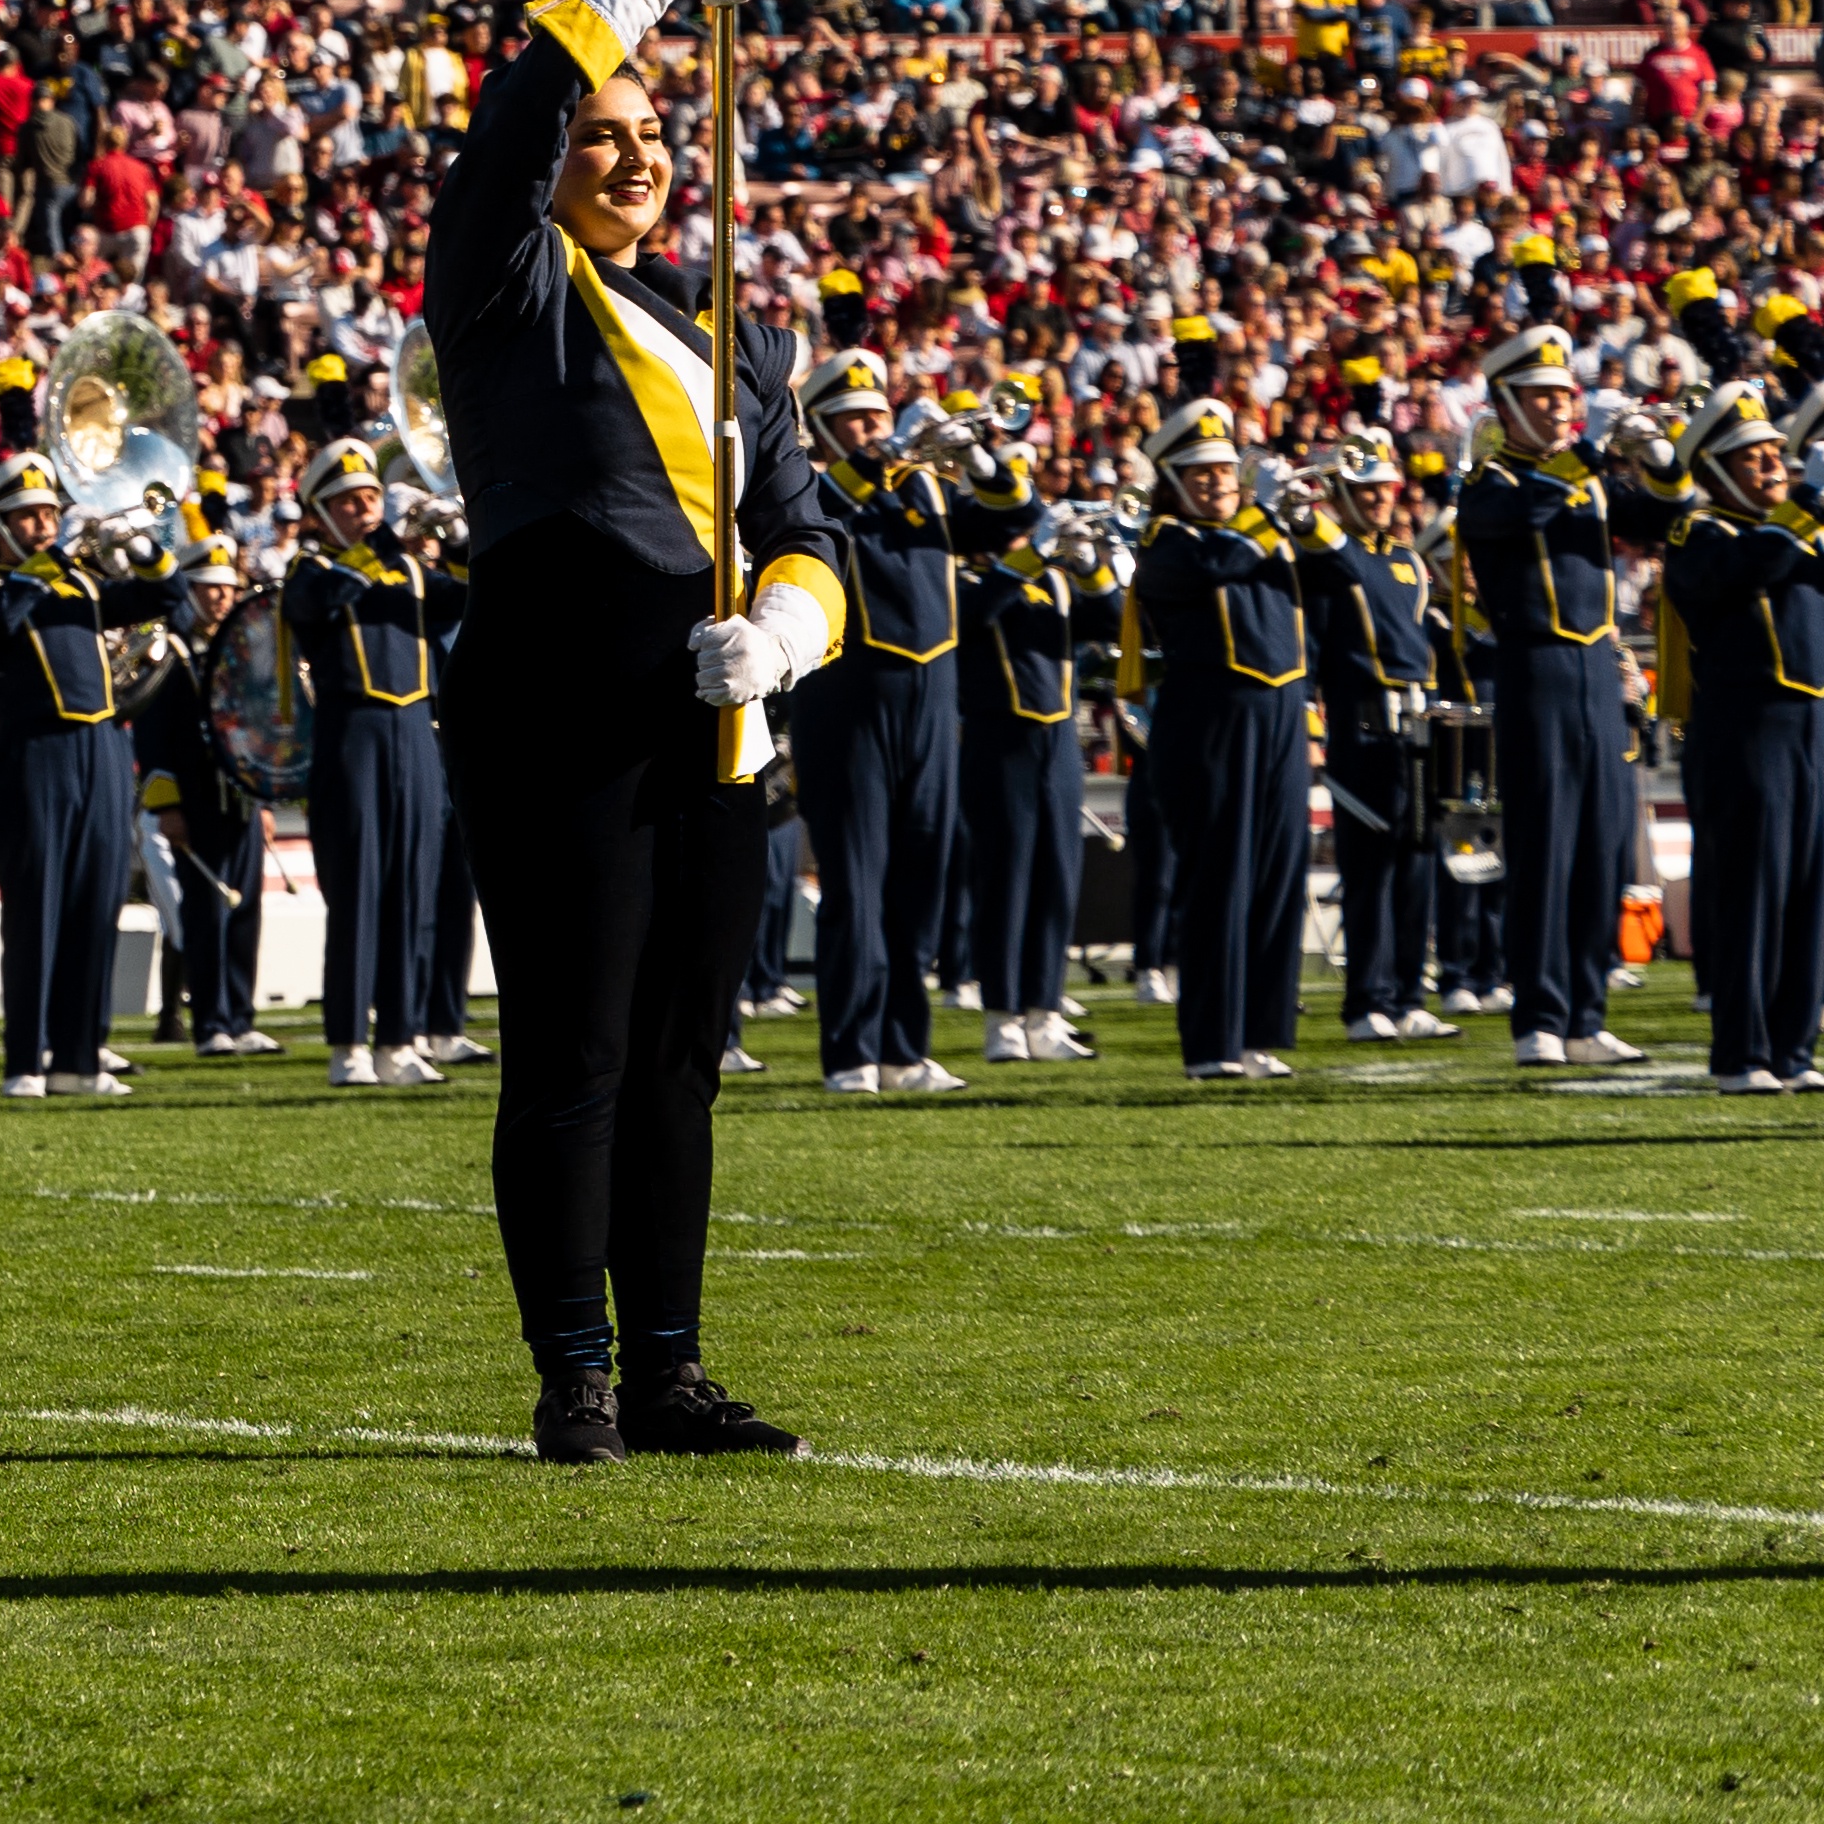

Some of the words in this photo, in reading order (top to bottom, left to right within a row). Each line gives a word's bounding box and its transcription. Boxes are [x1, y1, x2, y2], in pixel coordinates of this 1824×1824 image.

[1537, 341, 1565, 369] M
[842, 363, 876, 392] M
[1733, 395, 1769, 423] M
[1194, 414, 1230, 443] M
[337, 451, 369, 476] M
[19, 466, 50, 492] M
